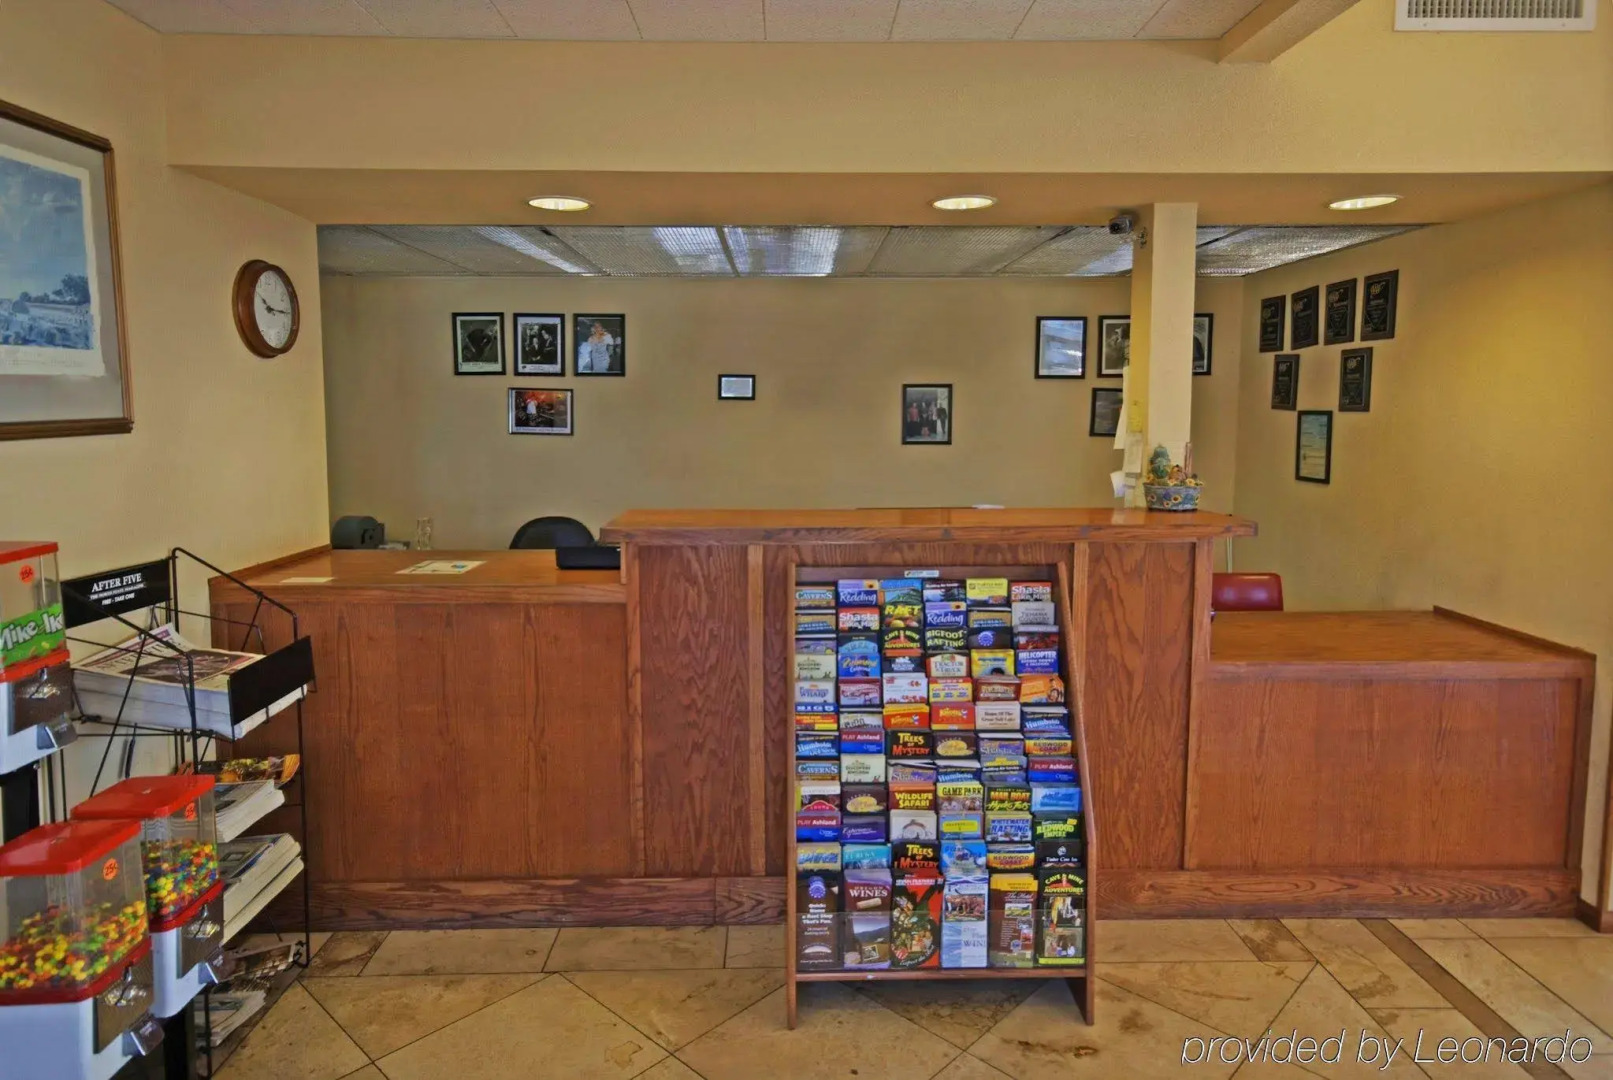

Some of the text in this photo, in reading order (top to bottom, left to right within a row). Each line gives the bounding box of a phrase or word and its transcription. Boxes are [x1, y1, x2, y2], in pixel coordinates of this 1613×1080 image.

[91, 573, 142, 593] AFTER FIVE
[1012, 585, 1050, 594] Shasta
[115, 595, 125, 603] TAKE
[125, 592, 136, 600] ONE
[796, 590, 834, 600] CAVERNS
[840, 592, 877, 604] Redding
[885, 604, 922, 615] RAFT
[840, 612, 878, 621] Shasta
[927, 612, 964, 625] Redding
[885, 631, 899, 641] CAVE
[905, 630, 921, 640] MINE
[927, 629, 963, 639] BIGFOOT
[885, 641, 921, 650] ADVENTURES
[927, 638, 965, 648] RAFTING
[1018, 651, 1057, 660] HELICOPTER
[898, 732, 924, 744] TREES
[892, 745, 930, 756] MYSTERY
[798, 763, 838, 774] CAVERNS
[895, 792, 933, 801] WILDLIFE
[942, 787, 983, 797] GAME PARK
[990, 792, 1009, 800] MAIL
[1011, 791, 1031, 800] BOAT
[899, 799, 930, 809] SAFARI
[991, 824, 1029, 833] RAFTING
[1037, 824, 1075, 834] REDWOOD
[906, 845, 933, 857] TREES
[901, 857, 938, 869] MYSTERY
[1045, 874, 1061, 885] CAVE
[1068, 874, 1084, 885] MINE
[849, 889, 888, 898] WINES
